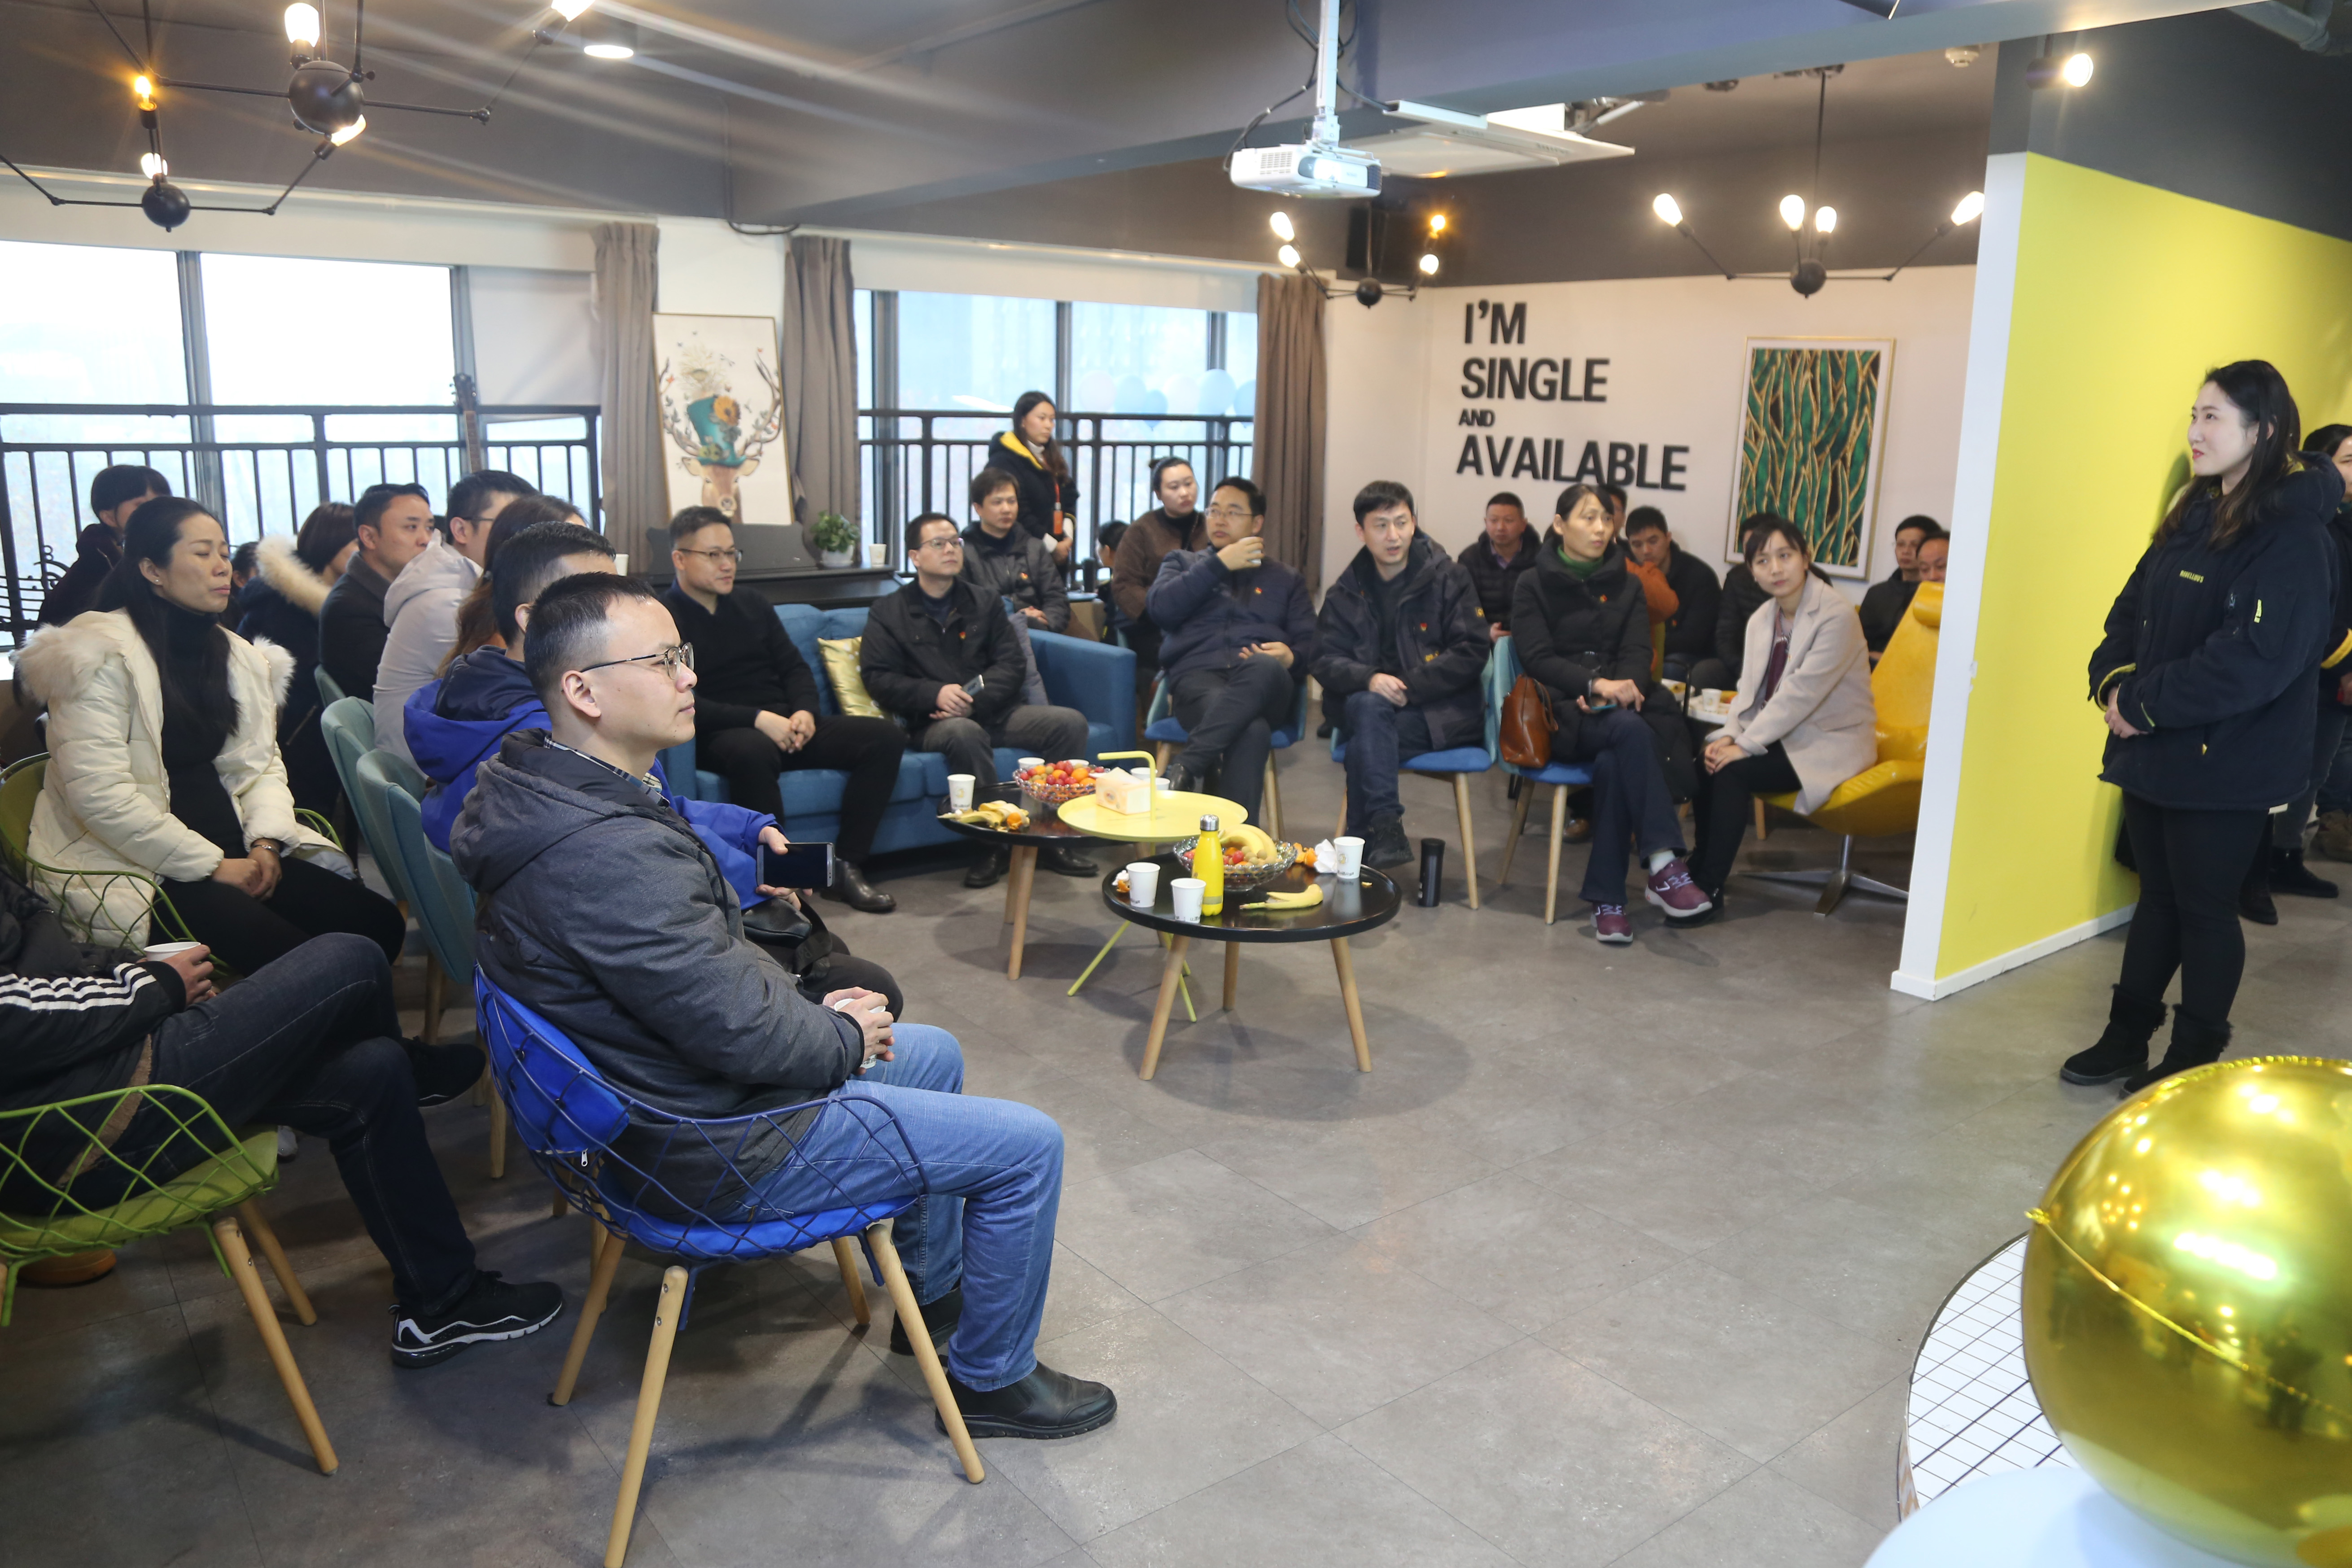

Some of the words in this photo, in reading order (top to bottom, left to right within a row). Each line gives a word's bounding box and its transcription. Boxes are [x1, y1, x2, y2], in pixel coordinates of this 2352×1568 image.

[1465, 299, 1527, 345] I'M
[1461, 358, 1609, 402] SINGLE
[1458, 409, 1495, 428] AND
[1456, 434, 1690, 492] AVAILABLE
